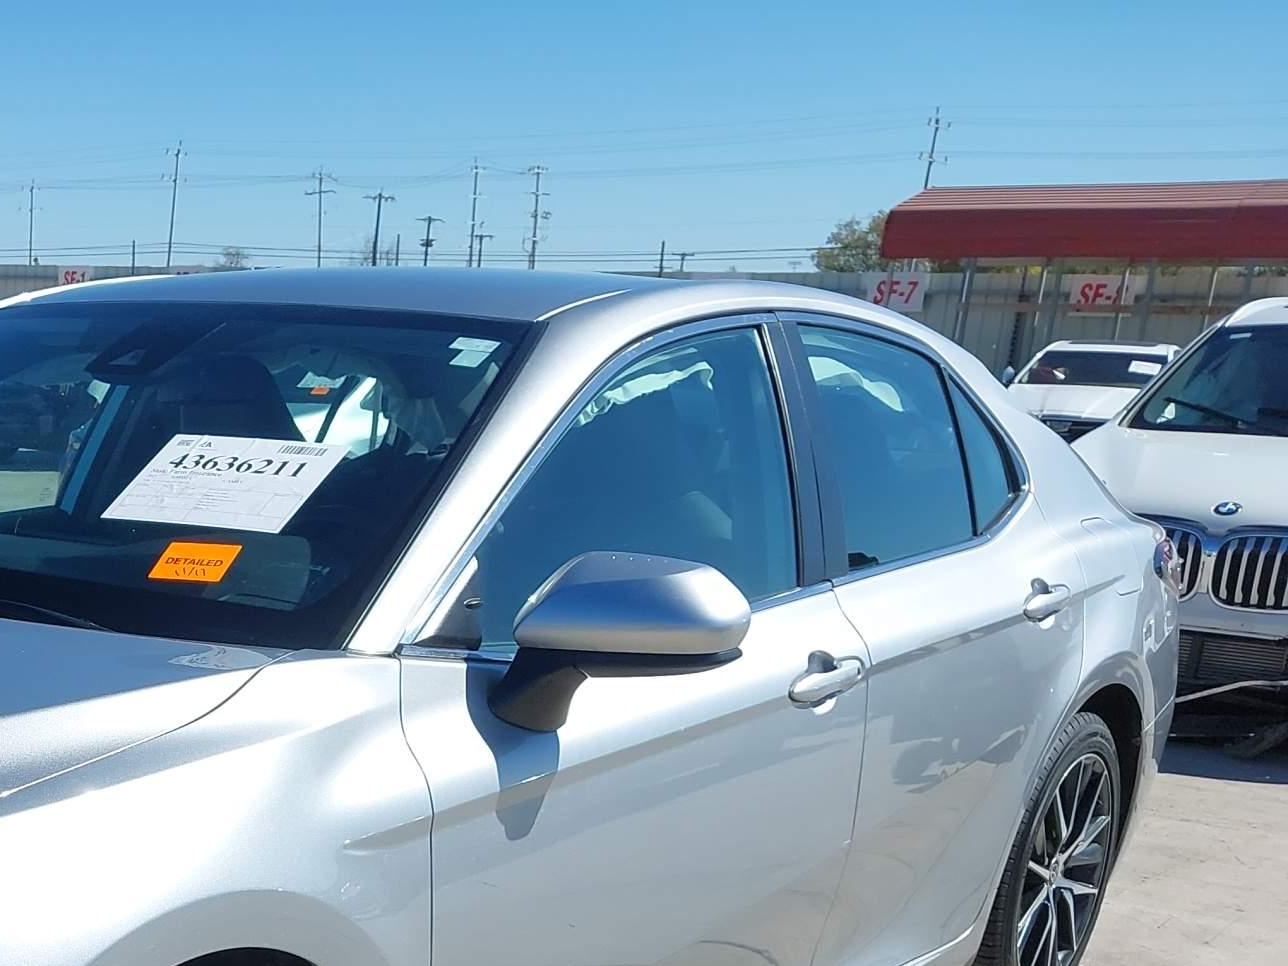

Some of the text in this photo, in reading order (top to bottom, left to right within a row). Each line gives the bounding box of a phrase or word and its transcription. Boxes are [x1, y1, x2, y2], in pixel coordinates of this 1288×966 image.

[872, 280, 919, 305] SF-7
[169, 453, 308, 478] 43636211
[165, 556, 224, 567] DETAILED
